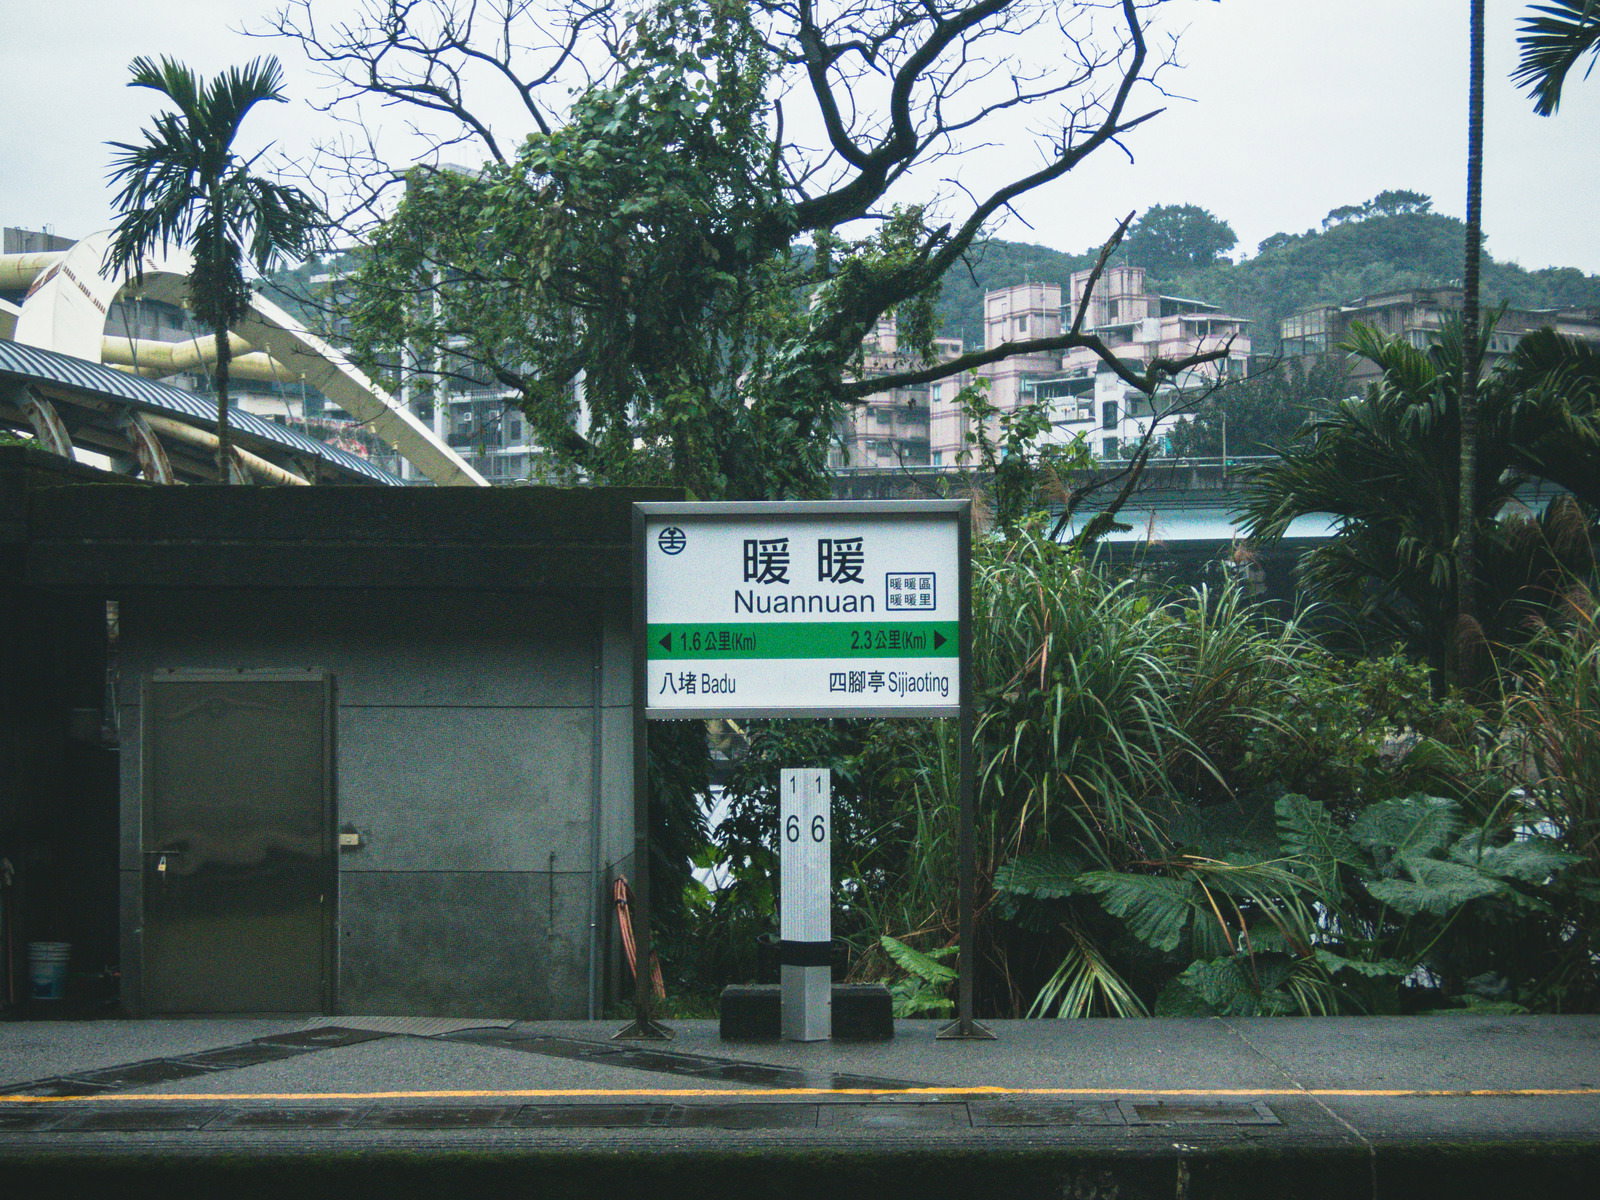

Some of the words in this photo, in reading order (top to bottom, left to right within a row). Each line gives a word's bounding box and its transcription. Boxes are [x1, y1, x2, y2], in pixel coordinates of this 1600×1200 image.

[743, 537, 864, 585] 暖暖
[889, 577, 932, 591] 暖暖區
[734, 589, 875, 613] Nuannuan
[889, 593, 932, 607] 暖暖里
[660, 671, 697, 695] 八堵
[701, 673, 736, 694] Badu
[829, 670, 886, 693] 四腳亭
[888, 671, 949, 698] Sijiaoting
[789, 775, 796, 794] 1
[815, 775, 822, 794] 1
[786, 814, 800, 842] 6
[811, 814, 825, 842] 6
